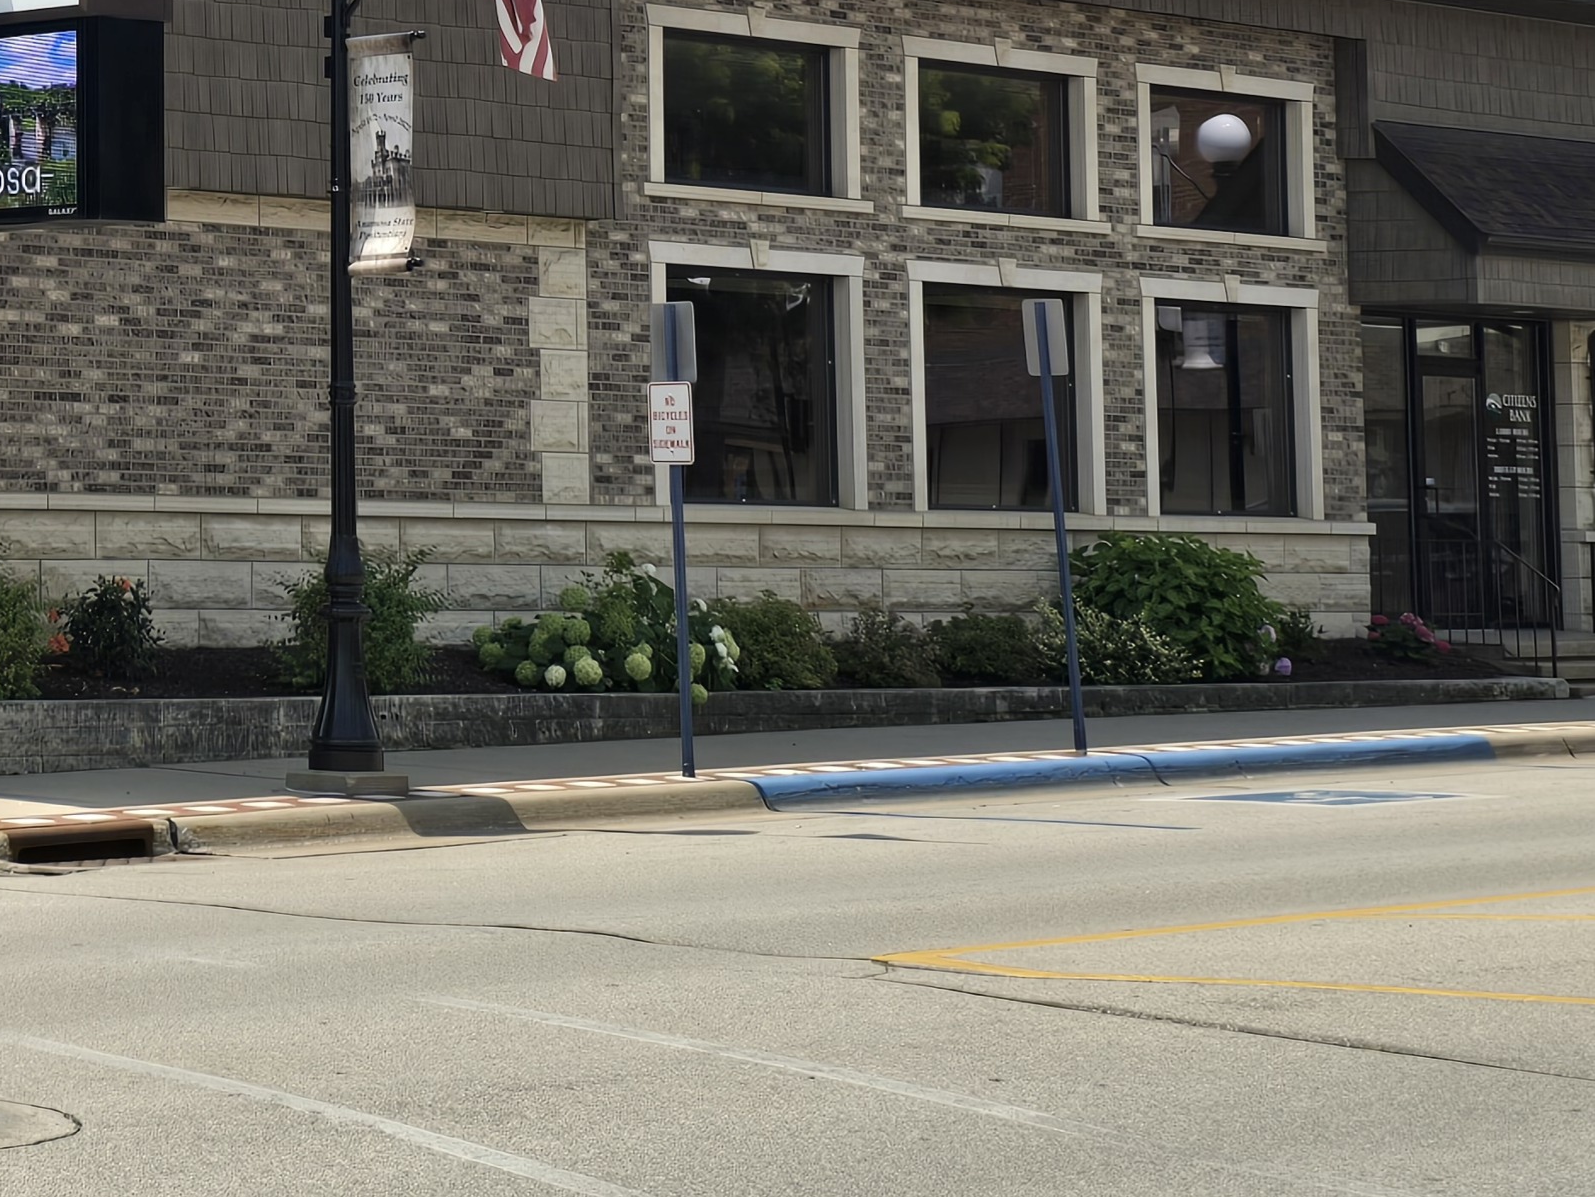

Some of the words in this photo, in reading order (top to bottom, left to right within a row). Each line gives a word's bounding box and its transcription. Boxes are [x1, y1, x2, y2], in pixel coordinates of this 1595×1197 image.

[354, 72, 409, 86] Celebrating
[376, 92, 403, 103] Years
[665, 396, 675, 406] NO
[1502, 394, 1537, 408] CITIZENS
[653, 411, 688, 420] BICYCLES
[1509, 409, 1532, 422] BANK
[666, 426, 676, 434] ON
[653, 440, 689, 449] SIDEWALK
